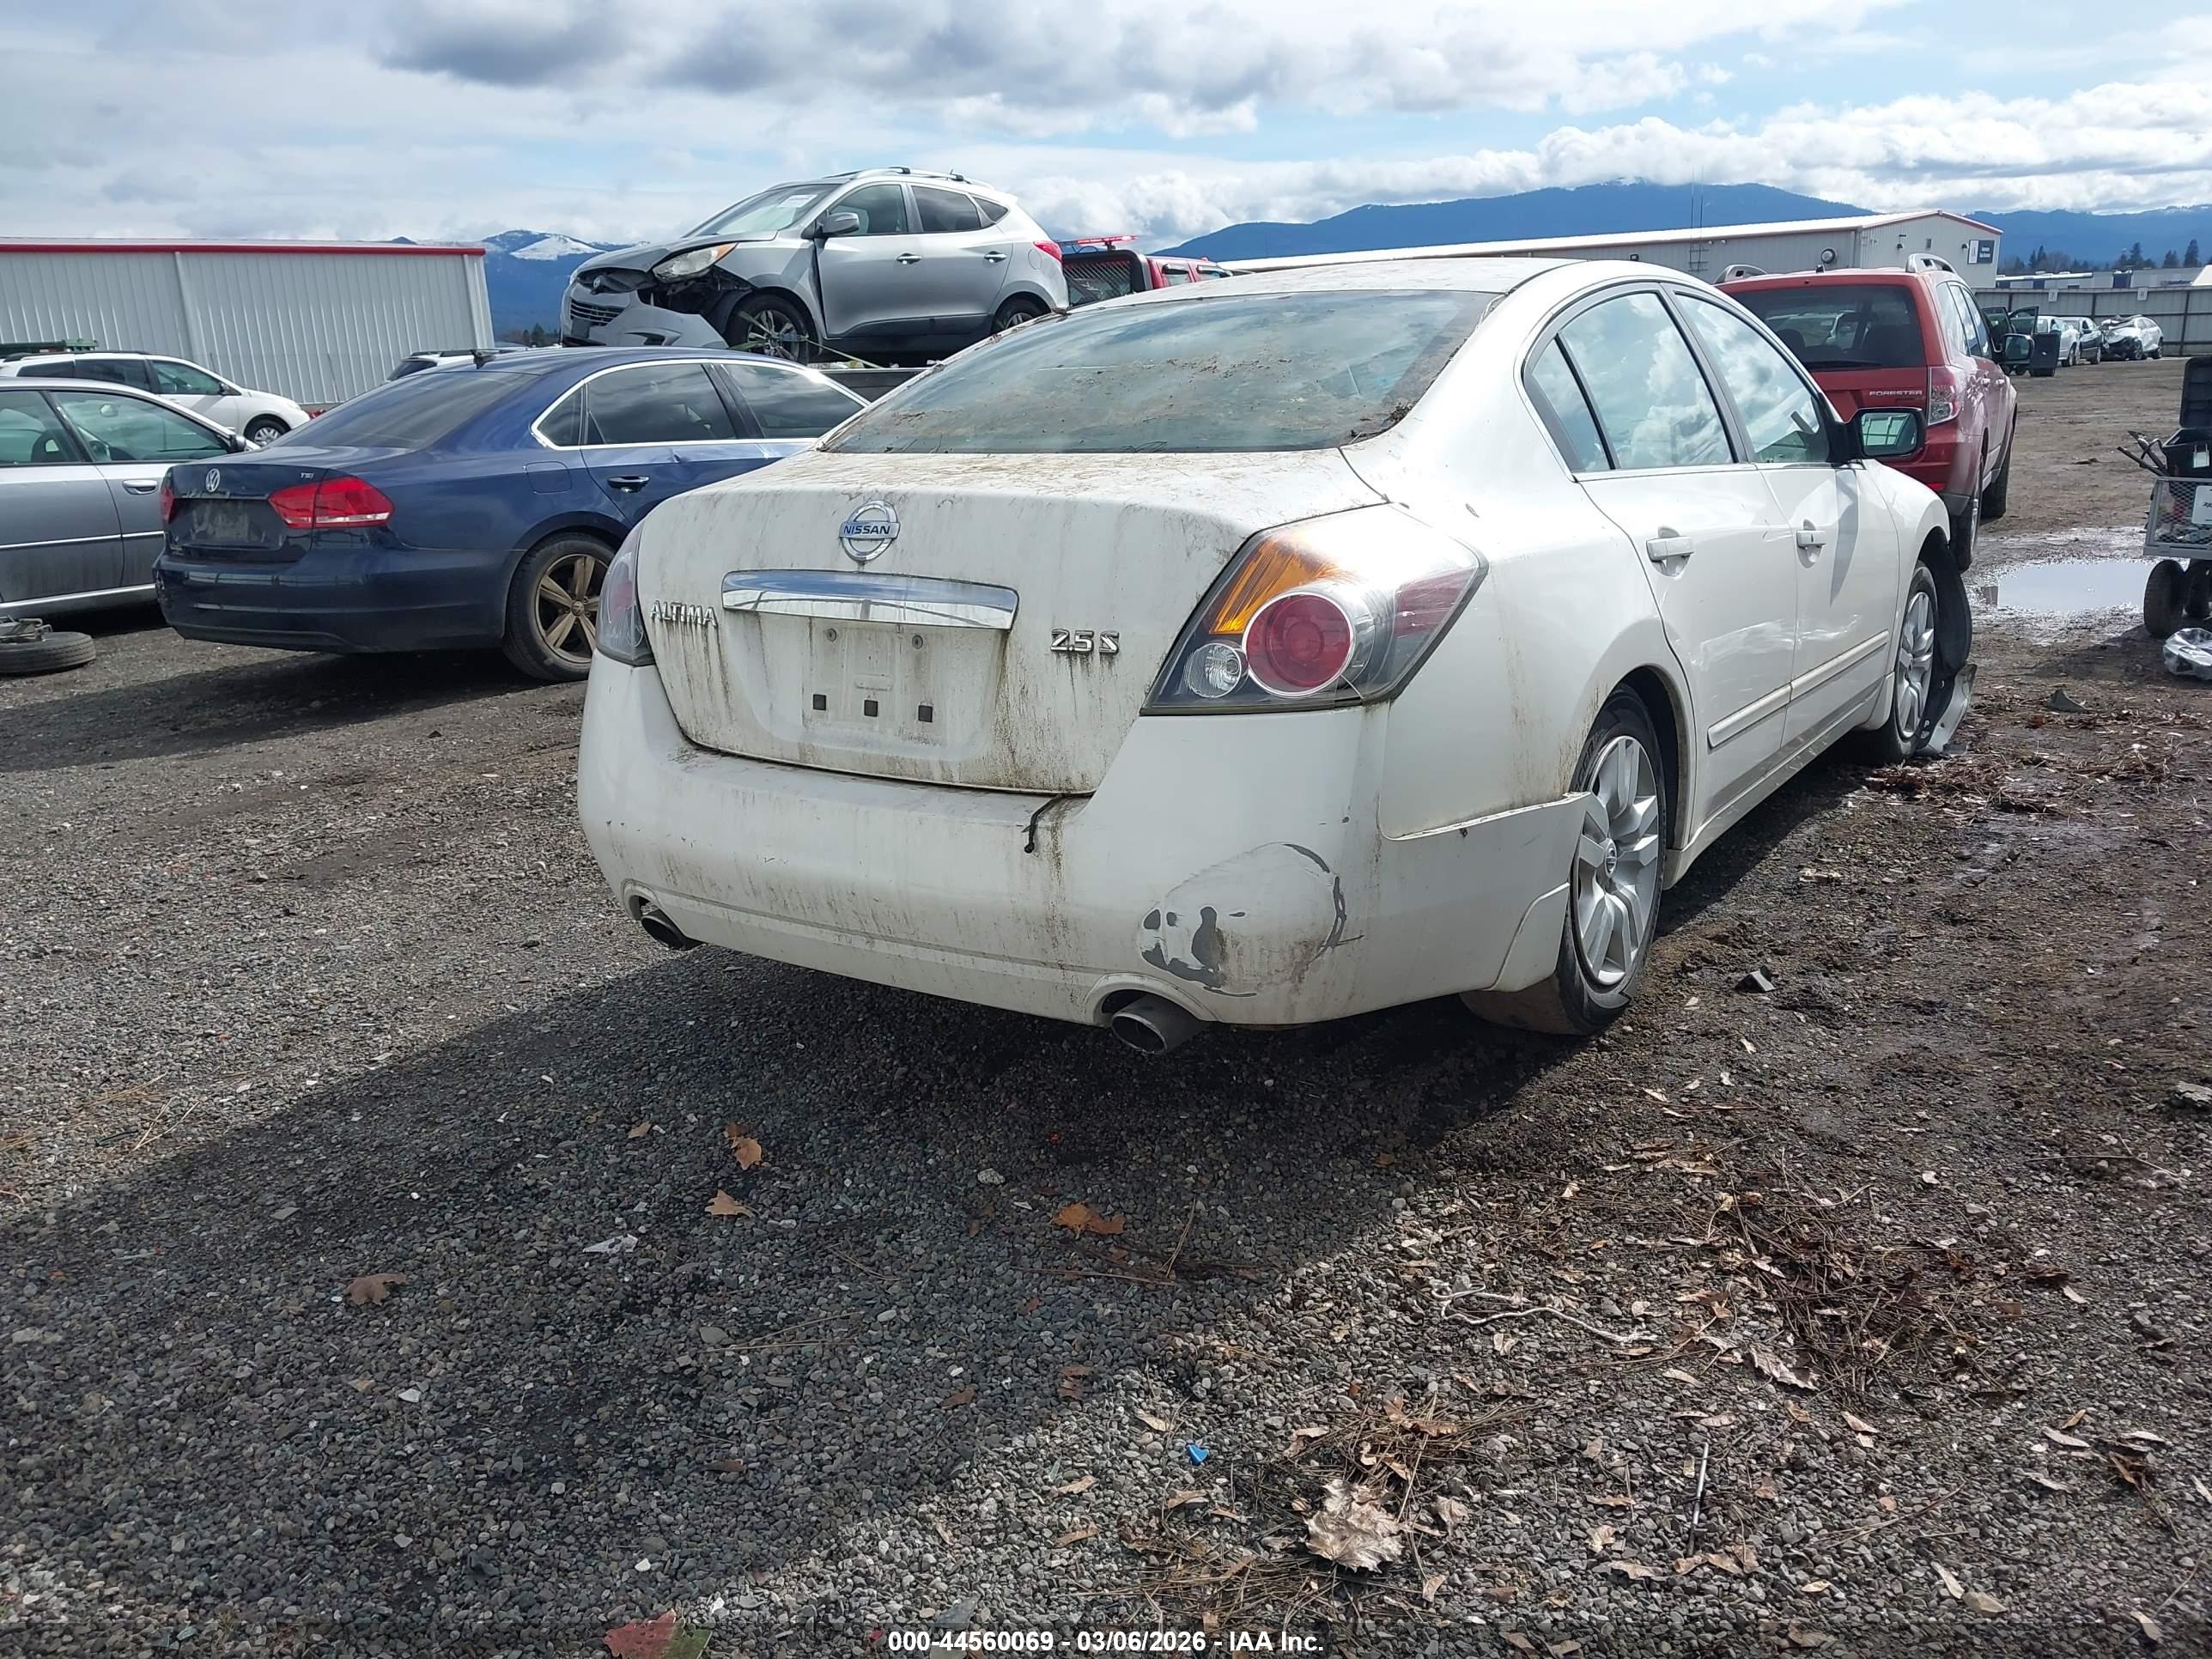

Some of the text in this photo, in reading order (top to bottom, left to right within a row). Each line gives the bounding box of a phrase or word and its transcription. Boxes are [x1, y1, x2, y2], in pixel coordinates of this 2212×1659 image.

[843, 526, 890, 535] NISSAN
[650, 600, 718, 628] ALTIMA
[1050, 629, 1120, 653] 2.5 S
